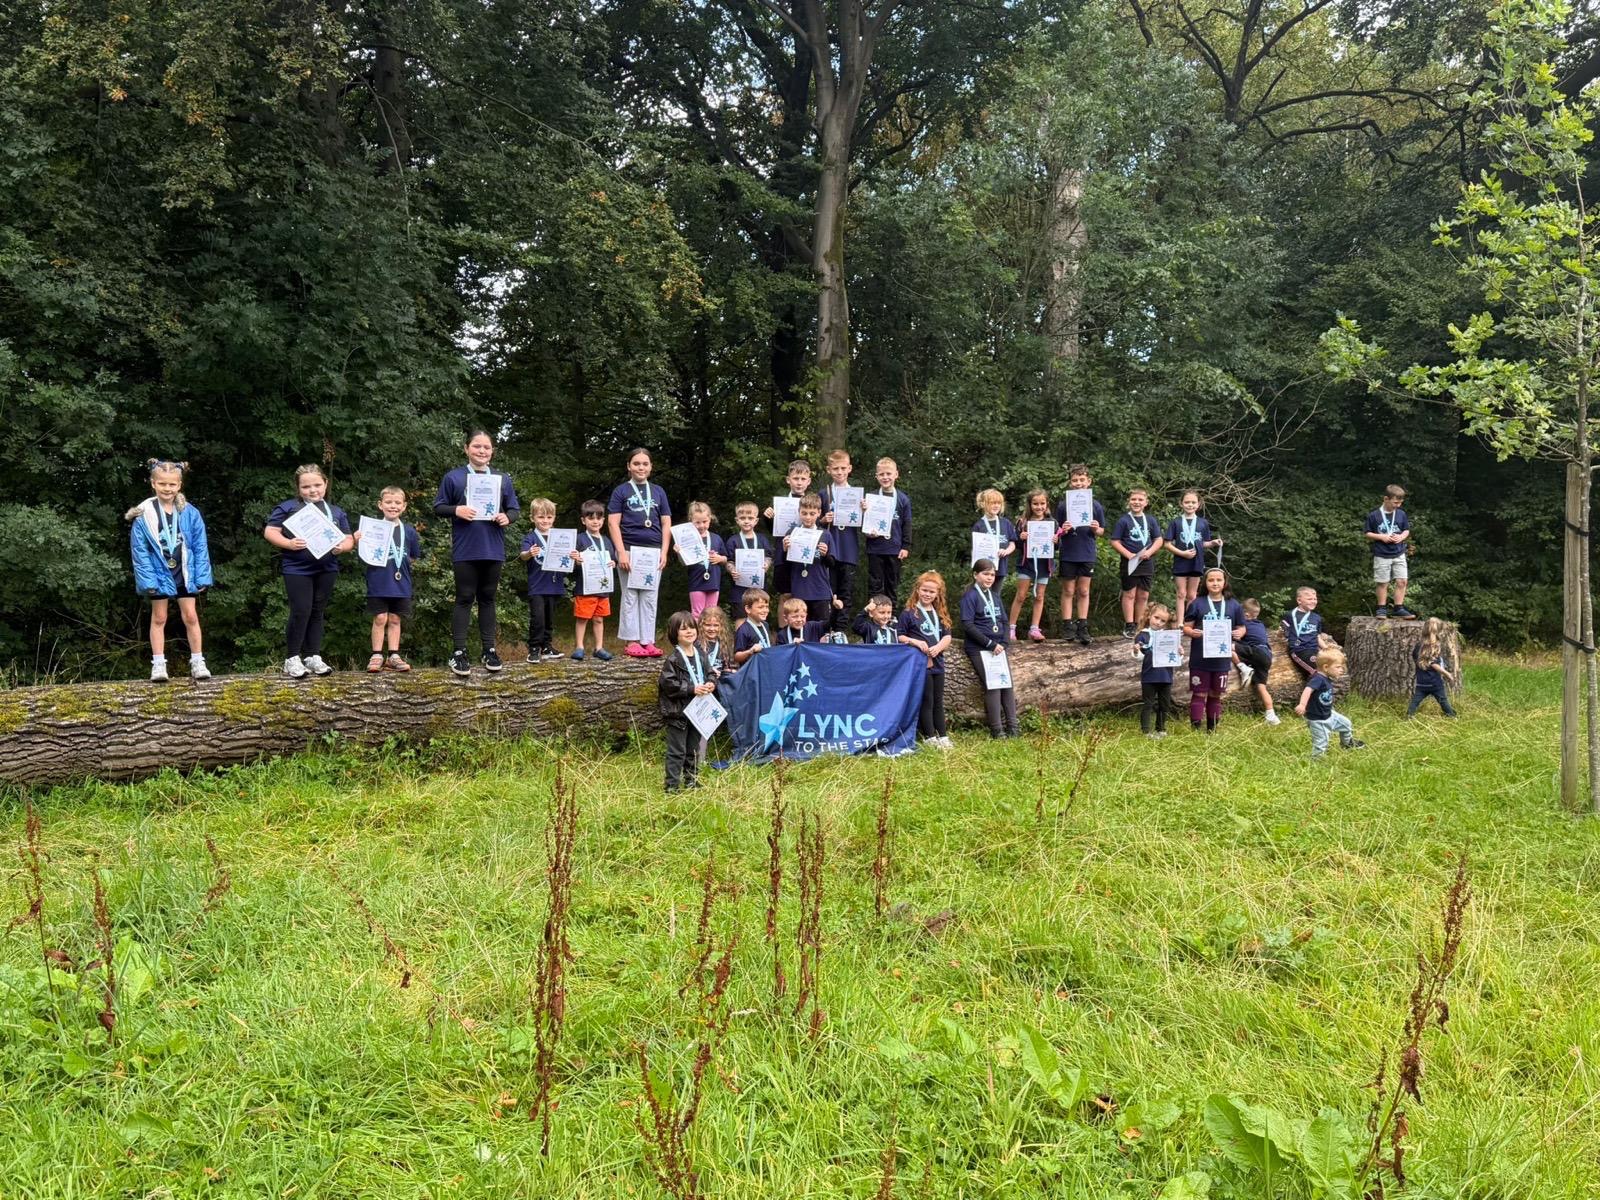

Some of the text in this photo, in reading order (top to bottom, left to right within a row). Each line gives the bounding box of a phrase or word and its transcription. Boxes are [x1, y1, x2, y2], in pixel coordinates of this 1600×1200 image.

[798, 714, 877, 738] LYNC
[795, 741, 814, 752] TO
[819, 741, 849, 752] THE
